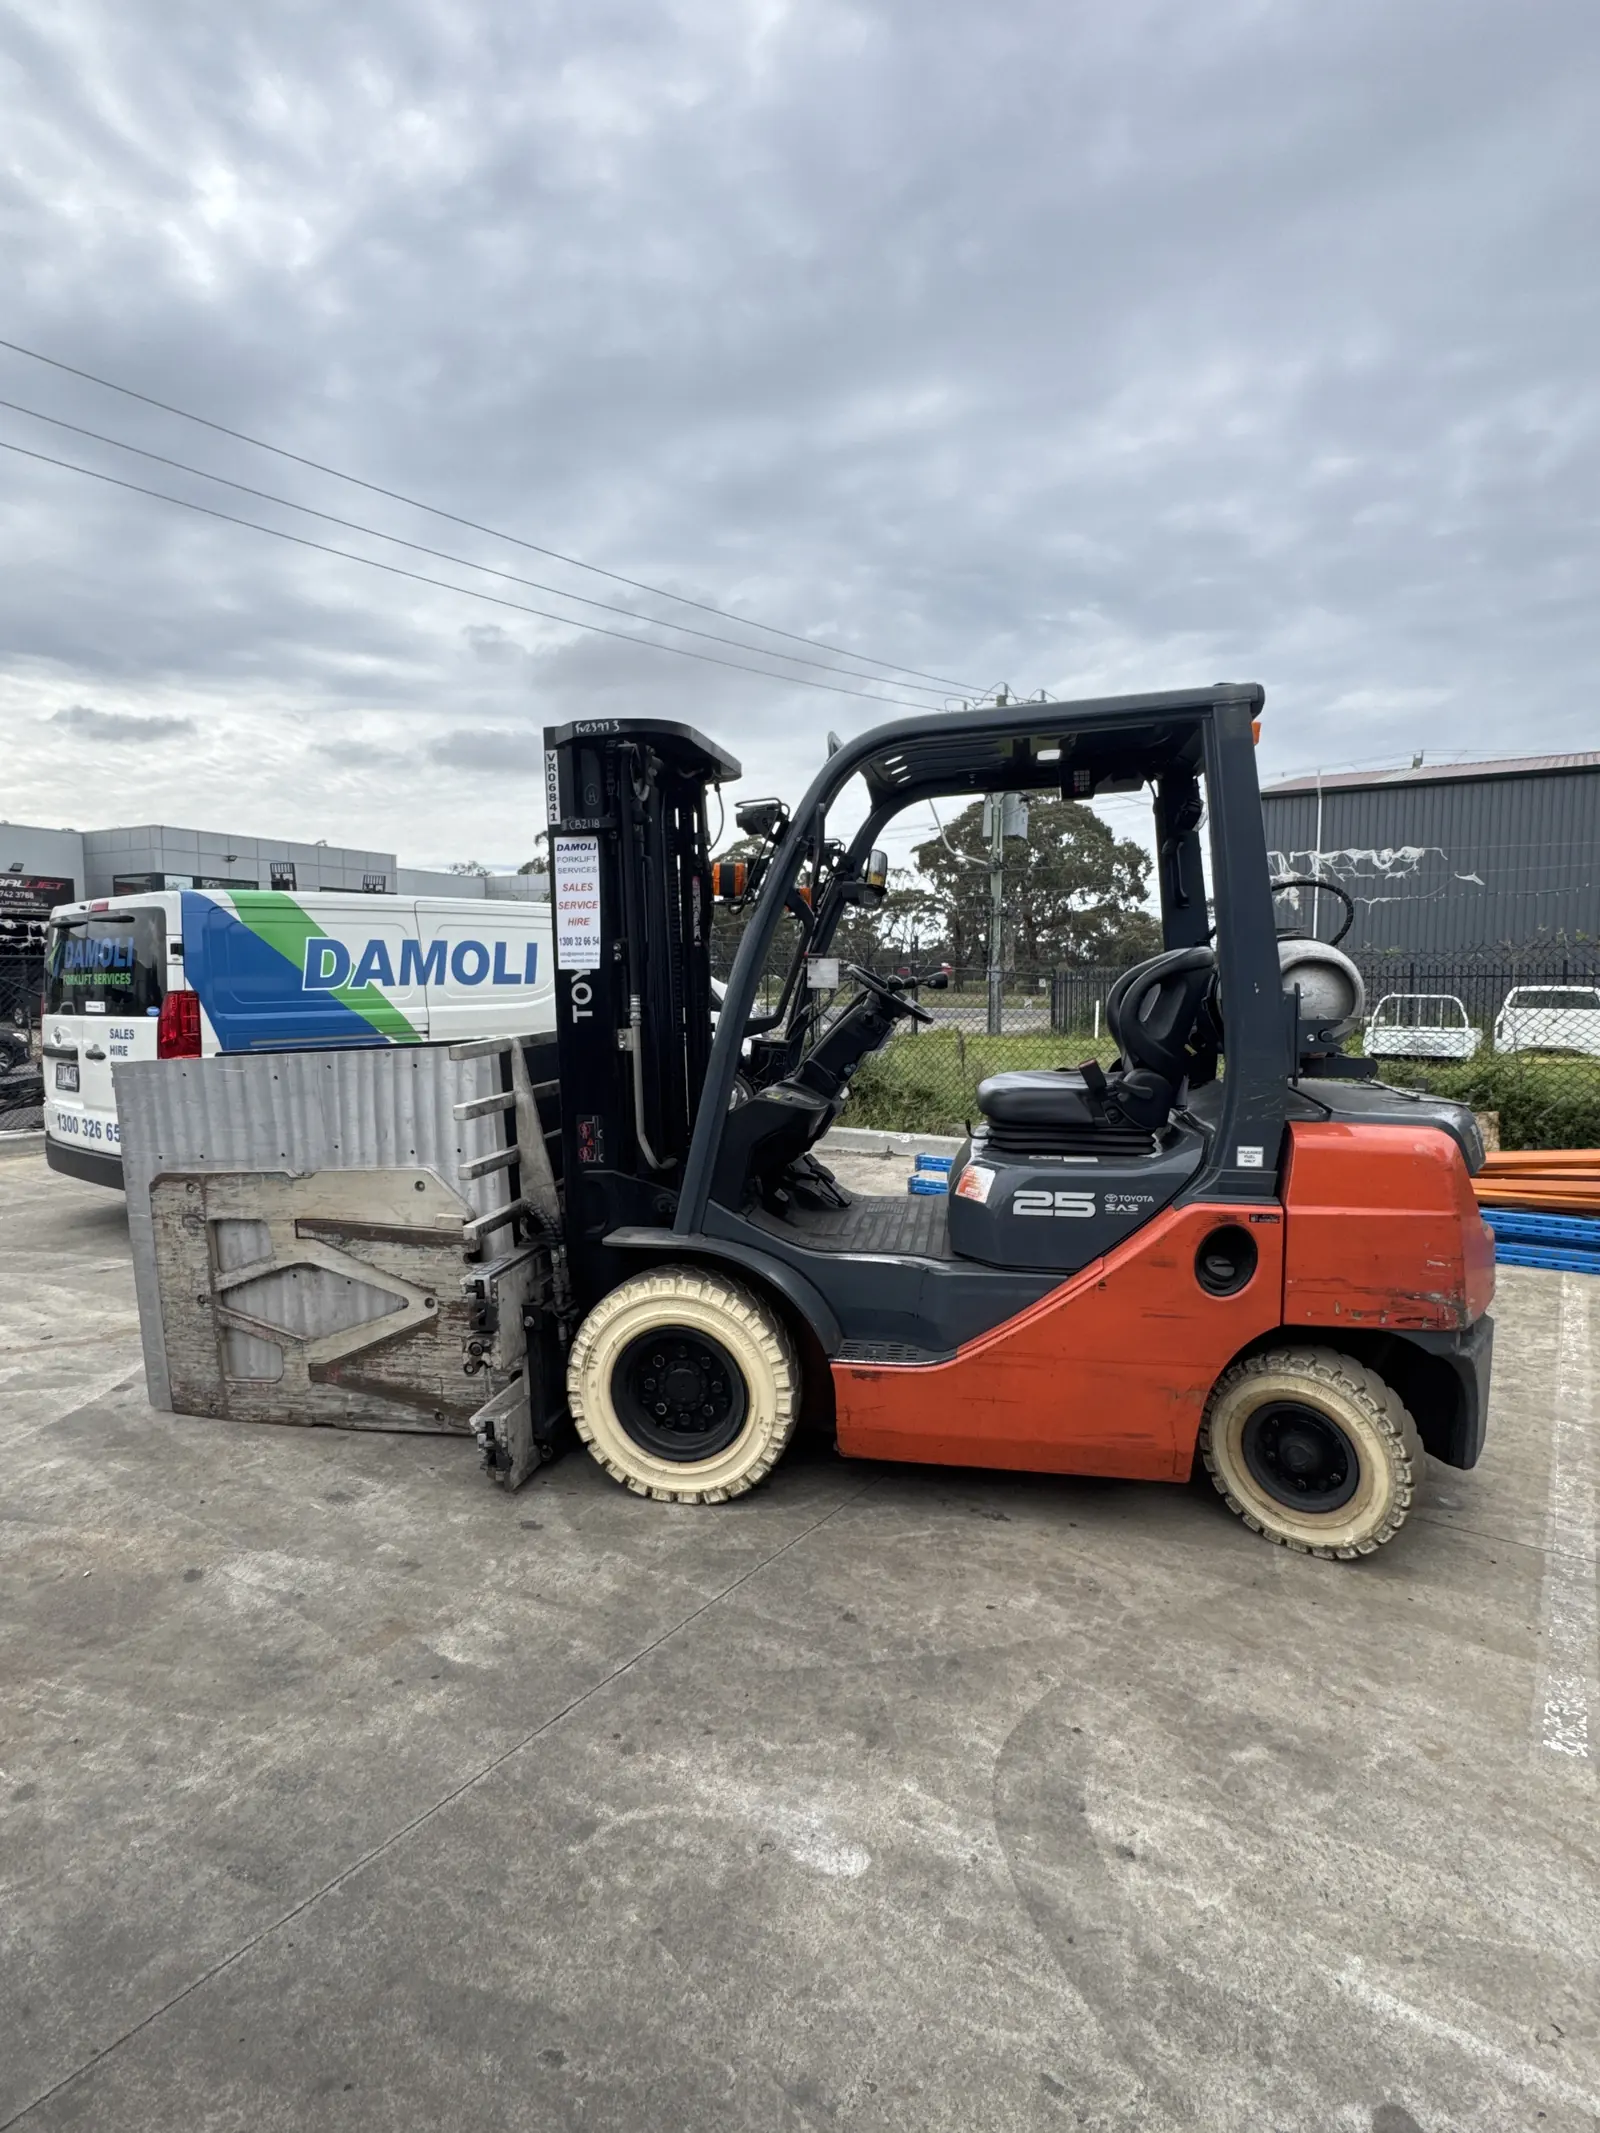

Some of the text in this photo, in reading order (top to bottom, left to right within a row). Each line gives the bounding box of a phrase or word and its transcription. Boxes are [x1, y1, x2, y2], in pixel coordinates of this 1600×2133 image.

[556, 842, 597, 852] DAMOLI
[556, 855, 597, 863] FORKLIFT
[557, 866, 598, 874] SERVICES
[562, 882, 594, 892] SALES
[558, 900, 599, 911] SERVICE
[567, 917, 591, 926] HIRE
[559, 936, 574, 946] 1300
[574, 936, 582, 946] 32
[64, 937, 135, 969] DAMOLI
[302, 936, 539, 992] DAMOLI
[63, 972, 132, 986] FORKLIFT SERVICES
[109, 1028, 135, 1040] SALES
[109, 1045, 129, 1057] HIRE
[57, 1112, 79, 1135] 1300
[82, 1118, 102, 1139] 326
[1119, 1194, 1155, 1203] TOYOTA
[1013, 1190, 1096, 1218] 25
[1104, 1203, 1139, 1212] SAS
